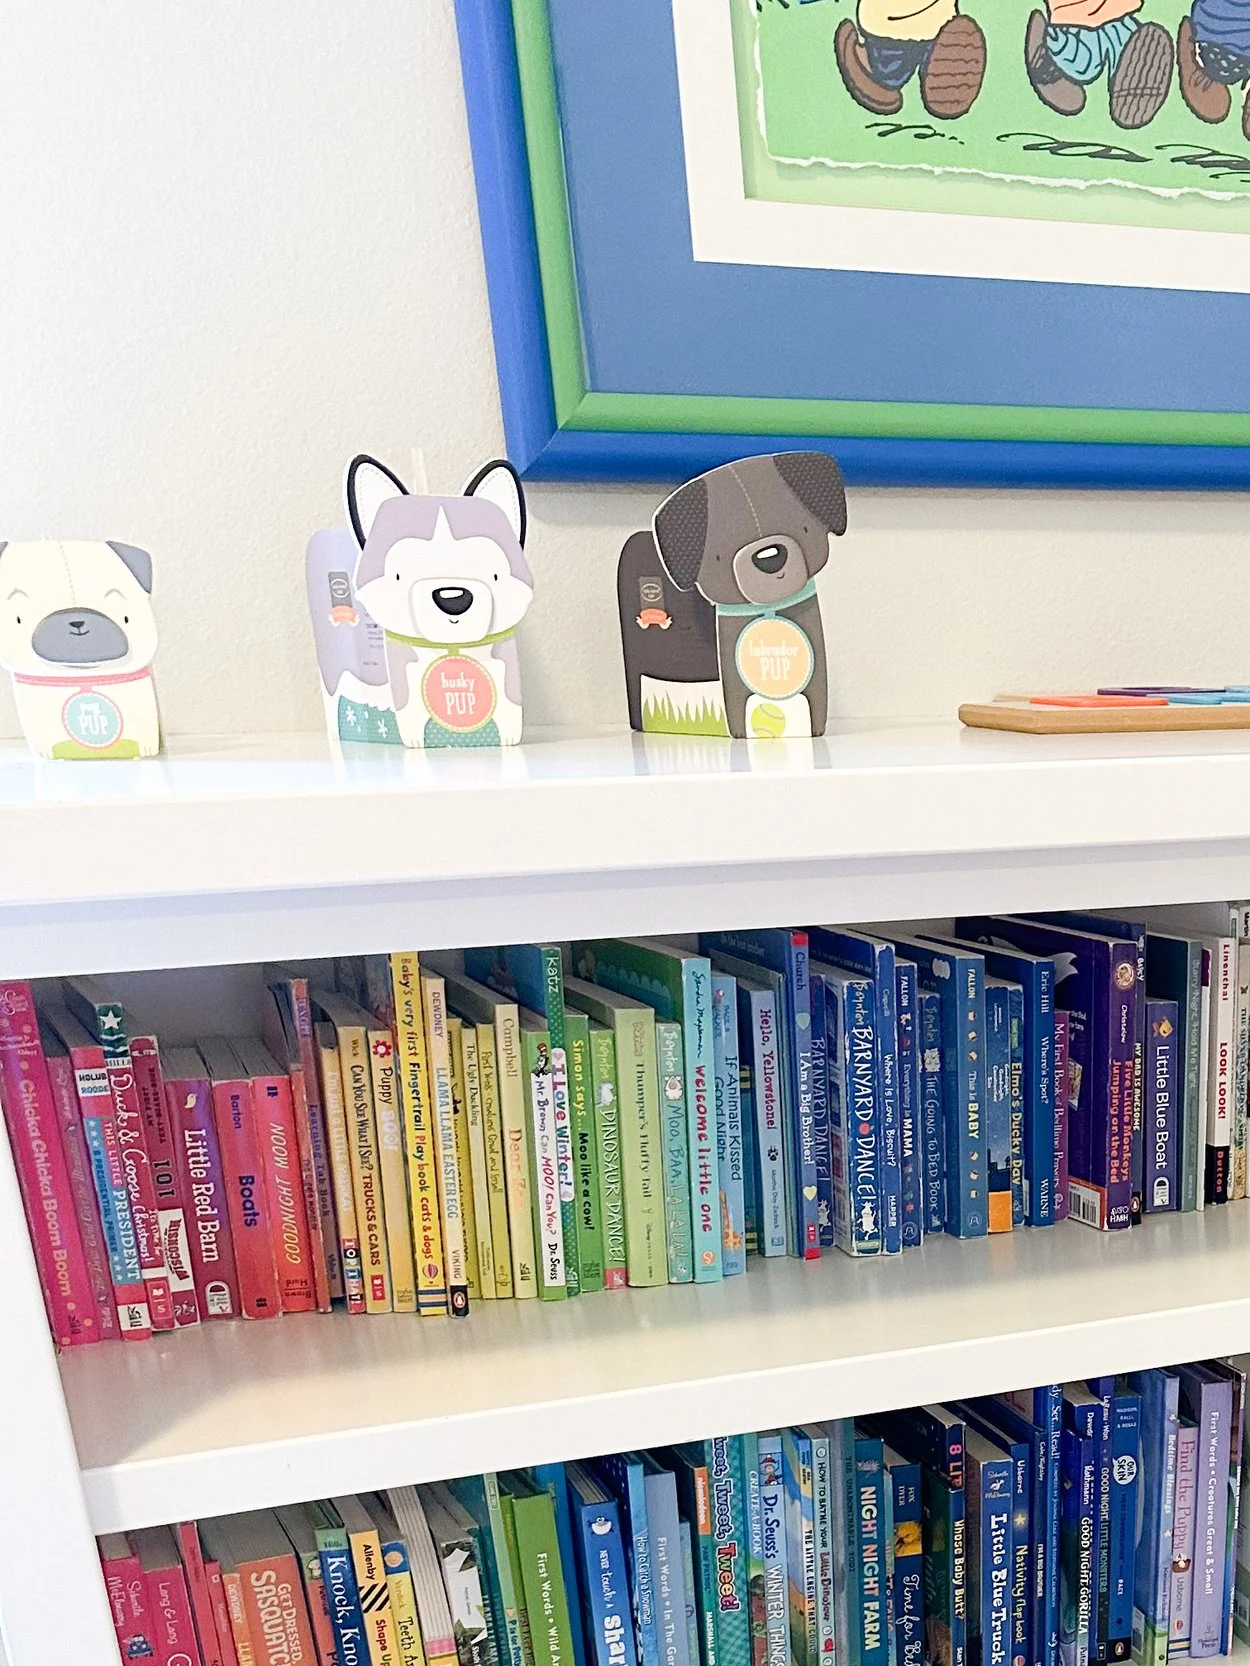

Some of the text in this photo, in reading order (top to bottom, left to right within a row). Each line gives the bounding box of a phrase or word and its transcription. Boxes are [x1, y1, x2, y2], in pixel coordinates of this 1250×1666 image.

[749, 639, 800, 658] labrador
[440, 672, 476, 692] husky
[760, 657, 790, 681] PUP
[444, 692, 476, 715] PUP
[78, 714, 109, 735] PUP
[397, 958, 412, 996] Baby's
[546, 957, 561, 994] katz
[401, 1000, 415, 1027] very
[406, 1030, 419, 1057] first
[572, 1040, 584, 1081] Simon
[760, 1009, 775, 1130] Hello, Yellowstone!
[968, 1071, 978, 1092] This
[1218, 1042, 1228, 1120] LOOK LOOK!
[408, 1062, 426, 1131] Fingertrail
[852, 1025, 878, 1201] BARNYARD DANCE!
[1155, 1046, 1170, 1170] Little Blue Boat
[536, 1098, 550, 1137] Brown
[552, 1063, 573, 1189] I Love Winter!
[968, 1103, 980, 1140] BABY
[1110, 1060, 1122, 1185] Jumping on the Bed
[1121, 1060, 1133, 1182] Five Little Monkeys
[118, 1129, 139, 1145] &
[542, 1134, 550, 1153] Can
[579, 1132, 589, 1161] Moo
[694, 1064, 712, 1233] welcome little one
[902, 1118, 913, 1158] MAMA
[20, 1080, 40, 1137] Chicka
[32, 1140, 53, 1197] Chicka
[43, 1200, 61, 1246] Boom
[53, 1250, 73, 1296] Boom
[122, 1149, 147, 1201] Goose
[154, 1160, 175, 1197] 101
[542, 1155, 555, 1191] MOO!
[581, 1163, 592, 1187] like
[601, 1109, 626, 1263] DINOSAUR DANCE!
[105, 1122, 141, 1279] THIS LITTLE PRESIDENT
[184, 1129, 220, 1263] Little Red Barn
[239, 1175, 260, 1228] Boats
[270, 1123, 301, 1264] GOODNIGHT MOON
[420, 1196, 433, 1222] cats
[582, 1190, 591, 1201] a
[132, 1206, 155, 1263] Christmas!
[422, 1225, 432, 1237] &
[545, 1208, 557, 1236] You?
[582, 1202, 595, 1231] cow!
[422, 1235, 433, 1260] dogs
[547, 1242, 558, 1256] Dr.
[550, 1258, 561, 1281] Seuss
[762, 1494, 778, 1517] Dr.
[714, 1478, 742, 1612] Tweet, Tweet!
[764, 1518, 780, 1559] Seuss's
[1081, 1516, 1090, 1548] GOOD
[362, 1544, 376, 1581] Allenby
[536, 1552, 548, 1578] First
[860, 1486, 881, 1651] NIGHT NIGHT FARM
[327, 1555, 356, 1624] Knock,
[541, 1579, 555, 1618] Words
[765, 1563, 785, 1621] WINTER
[903, 1574, 920, 1613] Time
[990, 1513, 1008, 1665] Little Blue Truck
[277, 1583, 304, 1664] GET DRESSED,
[895, 1615, 920, 1641] for
[1079, 1587, 1089, 1634] GORILLA
[375, 1619, 388, 1652] Shape
[548, 1625, 561, 1652] Wild
